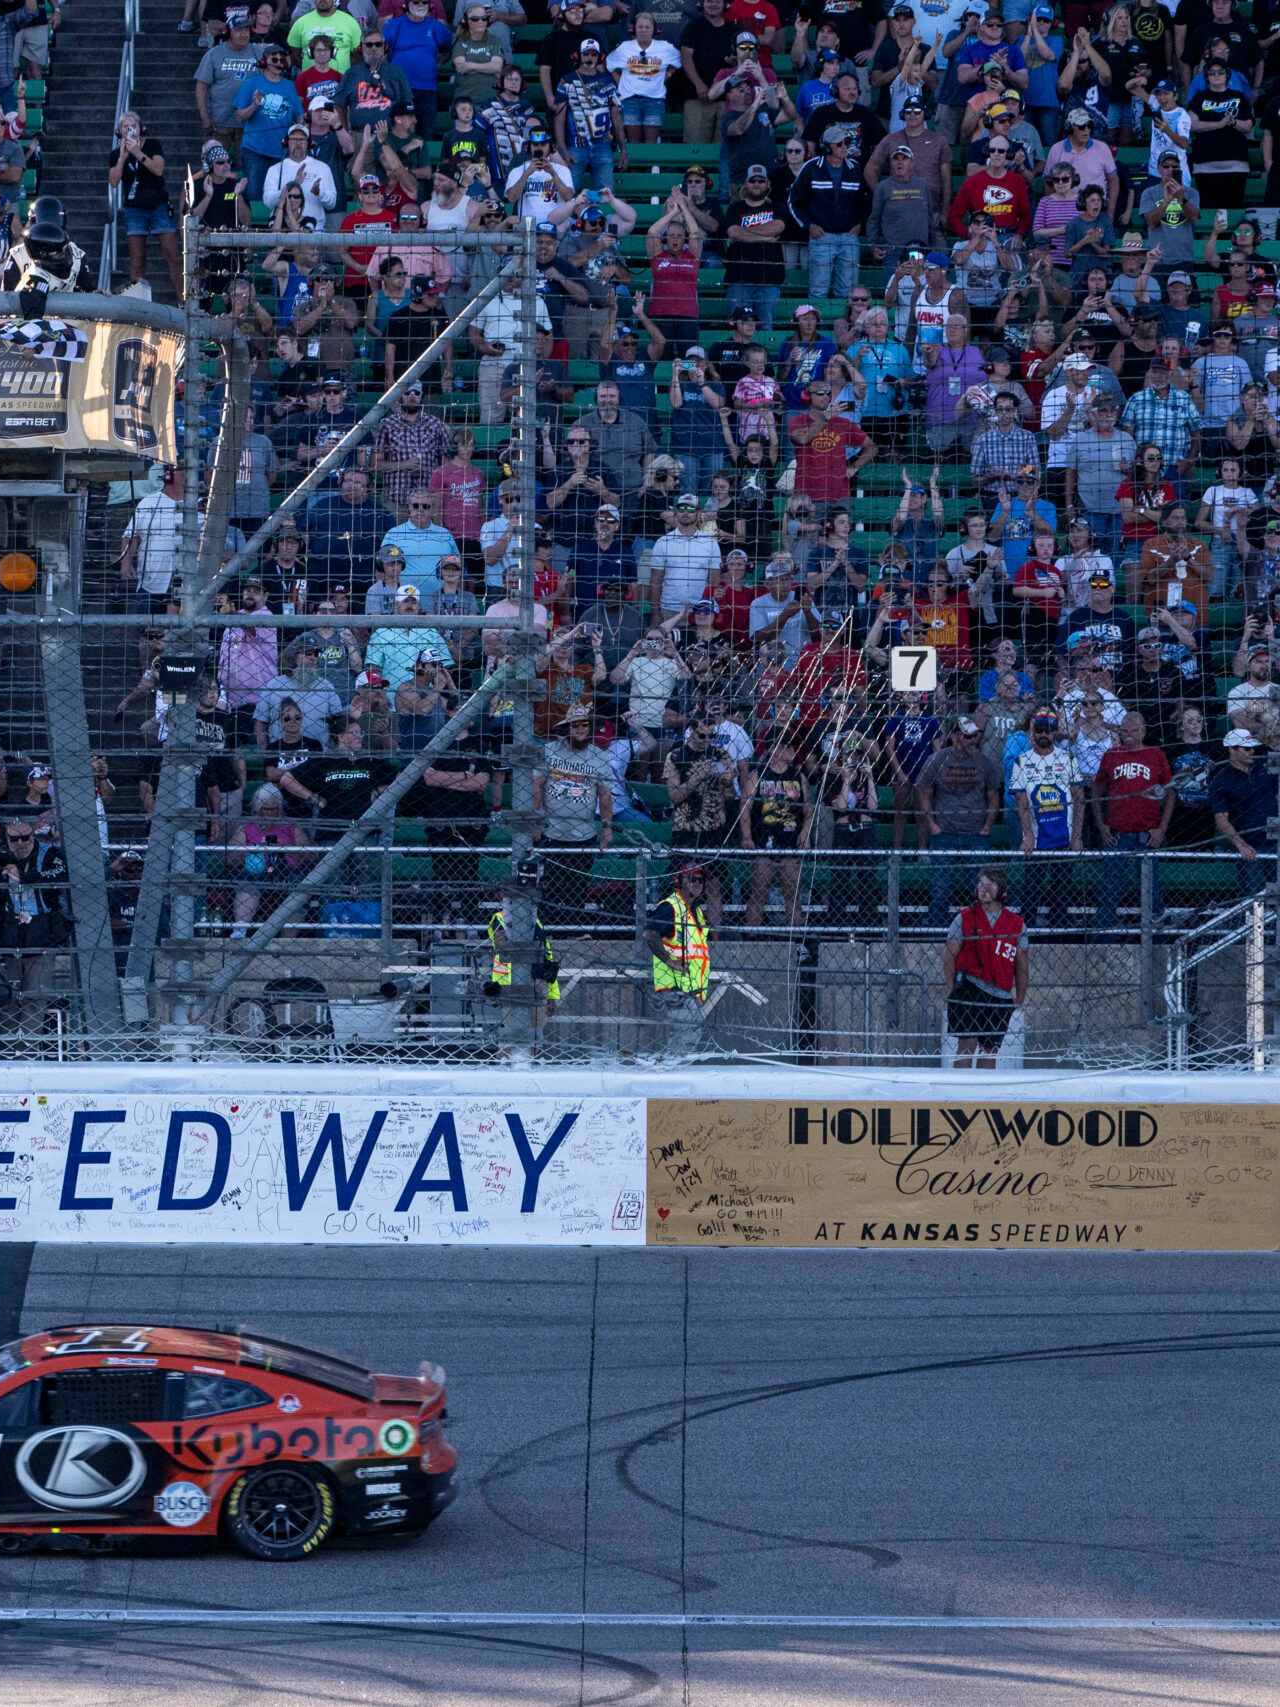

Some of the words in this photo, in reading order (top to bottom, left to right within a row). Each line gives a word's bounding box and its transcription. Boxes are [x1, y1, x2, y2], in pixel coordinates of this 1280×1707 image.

[1202, 98, 1240, 109] ELLIOTT
[451, 141, 477, 156] BLANEY
[983, 204, 1013, 214] CHIEFS
[1, 371, 63, 394] 400
[16, 401, 62, 409] SPEEDWAY
[34, 417, 57, 426] BET
[295, 579, 307, 590] 19
[166, 665, 196, 673] WHELEN
[898, 650, 928, 687] 7
[325, 772, 370, 782] REDDICK
[1114, 763, 1151, 780] CHIEFS
[270, 1099, 308, 1112] RAISE
[789, 1107, 1158, 1147] HOLLYWOOD
[879, 1133, 1052, 1195] Casino
[1085, 1165, 1120, 1183] GO
[1128, 1165, 1177, 1182] DENNY
[1204, 1165, 1240, 1184] GO
[1242, 1165, 1273, 1182] #22
[706, 1193, 754, 1207] Michael
[618, 1200, 641, 1218] 12
[717, 1209, 738, 1219] GO
[323, 1212, 358, 1235] GO
[815, 1222, 845, 1240] AT
[861, 1223, 979, 1241] KANSAS
[990, 1224, 1127, 1243] SPEEDWAY
[173, 1417, 376, 1466] Kubota
[156, 1496, 211, 1512] BUSCH
[166, 1511, 199, 1521] LIGHT
[365, 1508, 409, 1521] JOCKEY
